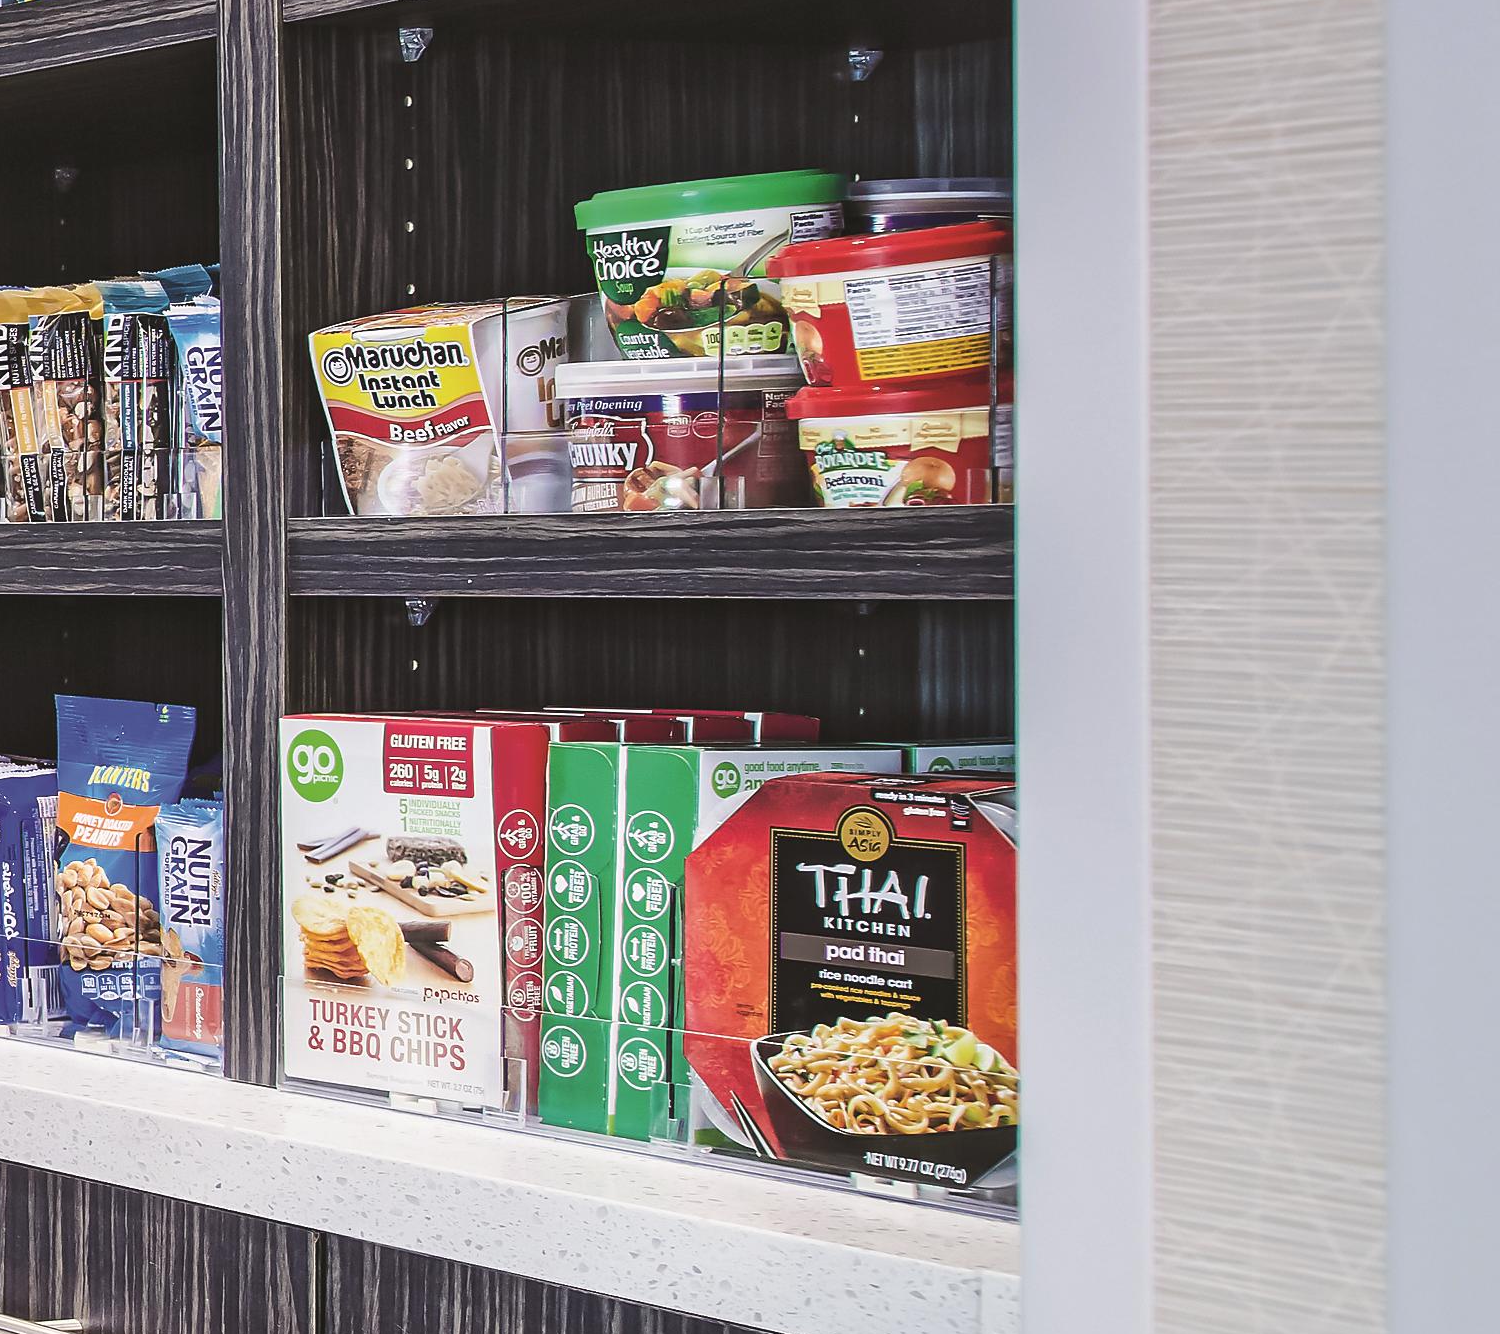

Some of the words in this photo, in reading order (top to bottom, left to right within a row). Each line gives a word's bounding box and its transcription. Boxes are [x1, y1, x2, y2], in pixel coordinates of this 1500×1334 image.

[747, 227, 765, 239] Fiber
[592, 232, 664, 260] Healthy
[595, 255, 662, 281] Choice
[616, 280, 635, 296] Soup
[618, 330, 660, 349] Country
[346, 340, 465, 370] Maruchan
[358, 370, 441, 392] Instant
[372, 391, 438, 411] Lunch
[576, 398, 594, 411] Peel
[594, 397, 643, 413] Opening
[389, 420, 435, 443] Beef
[434, 414, 469, 437] Flavor
[569, 440, 639, 471] CHUNKY
[813, 450, 889, 473] BOYARDEE
[823, 473, 886, 491] Beefaroni
[390, 734, 435, 750] GLUTEN
[437, 737, 466, 751] FREE
[291, 744, 337, 783] go
[389, 764, 414, 779] 260
[424, 767, 440, 782] 5g
[88, 765, 152, 793] PLANTERS
[450, 768, 467, 783] 2g
[72, 812, 101, 826] HONEY
[849, 828, 882, 838] SIMPLY
[169, 835, 192, 928] GRAIN
[187, 838, 213, 926] NUTRI
[795, 861, 931, 920] THAI
[823, 916, 912, 938] KITCHEN
[826, 943, 865, 964] pad
[868, 944, 905, 967] thai
[818, 967, 842, 981] rice
[843, 970, 885, 987] noodle
[887, 976, 912, 990] cart
[308, 998, 389, 1031] TURKEY
[397, 1010, 464, 1042] STICK
[308, 1029, 325, 1051] &
[332, 1029, 382, 1061] BBQ
[389, 1037, 466, 1071] CHIPS
